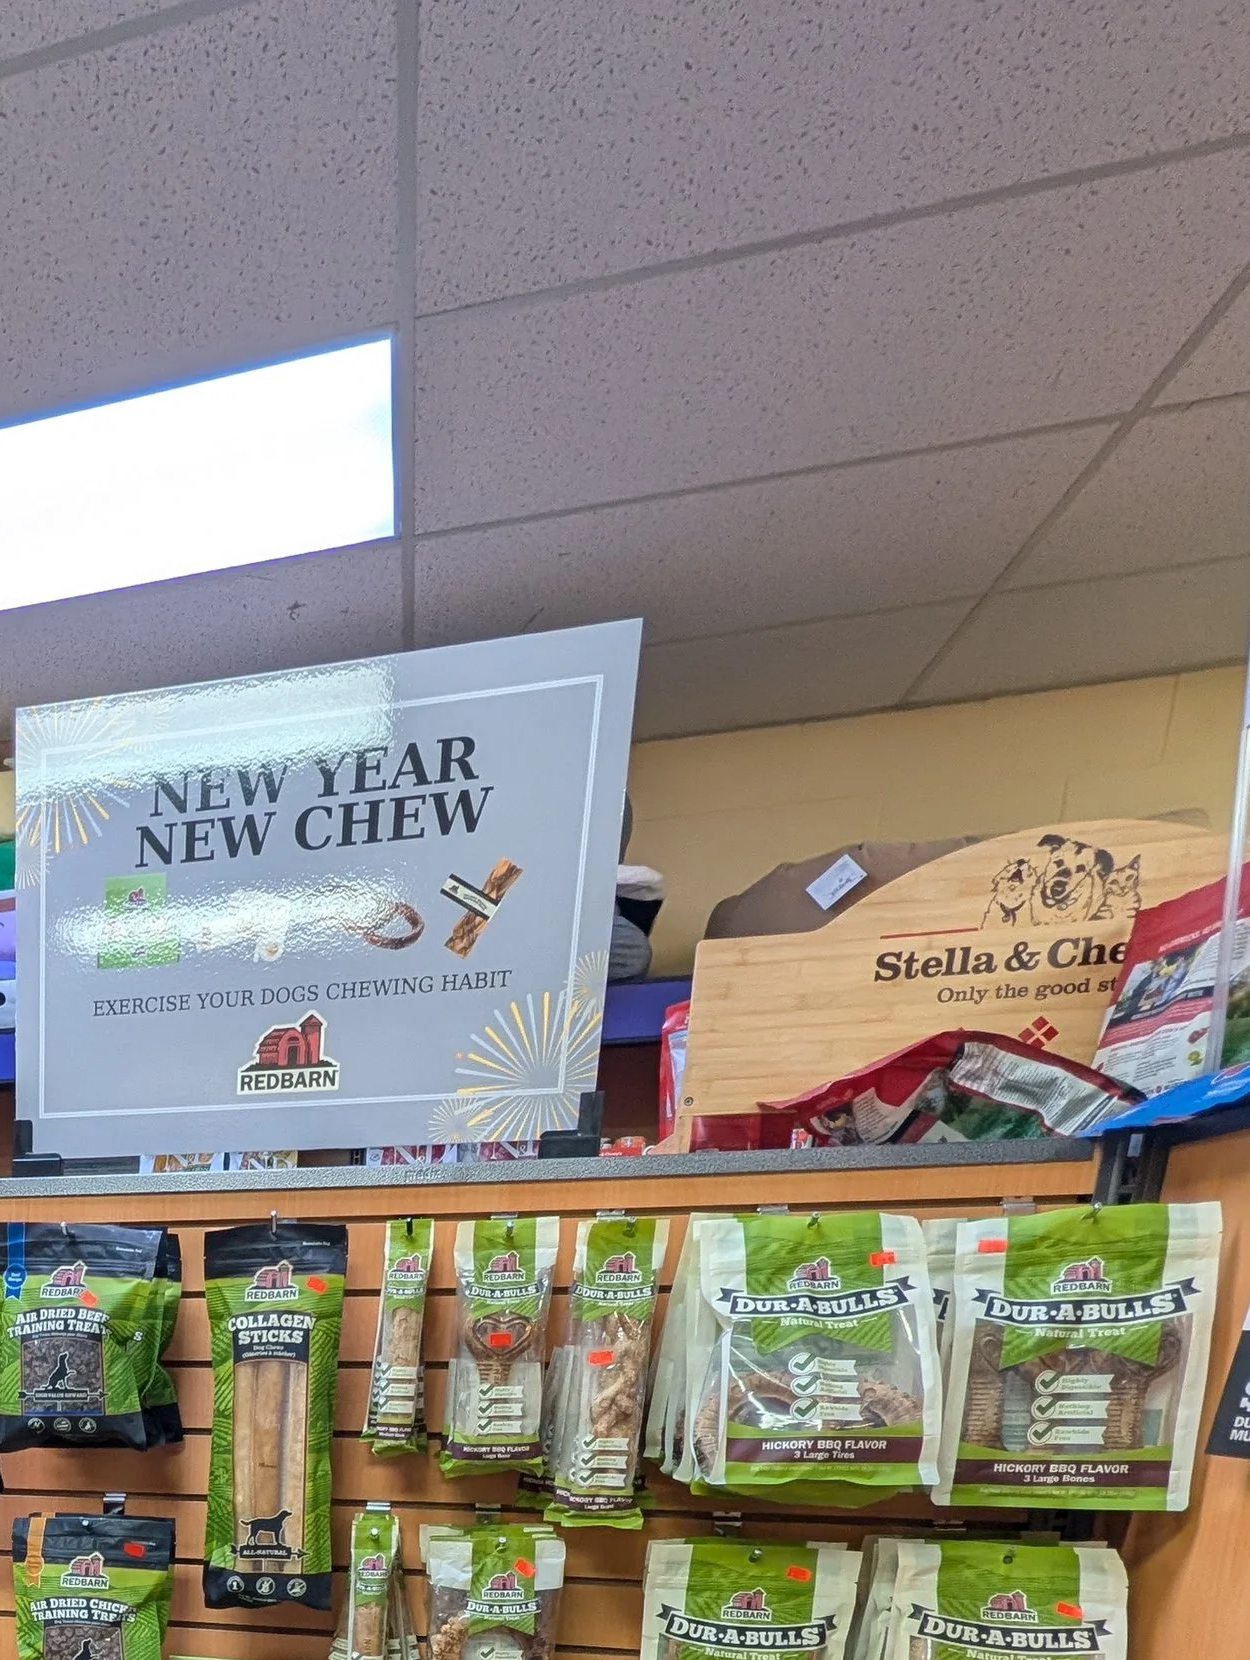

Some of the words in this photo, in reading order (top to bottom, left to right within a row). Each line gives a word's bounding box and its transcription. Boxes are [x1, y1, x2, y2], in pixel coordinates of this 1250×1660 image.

[149, 764, 288, 818] NEW
[316, 735, 479, 799] YEAR
[135, 812, 277, 868] NEW
[294, 786, 493, 852] CHEW
[874, 946, 996, 982] Stella
[1004, 942, 1039, 972] &
[92, 993, 191, 1017] EXERCISE
[196, 988, 256, 1009] YOUR
[260, 984, 319, 1006] DOGS
[325, 974, 435, 1001] CHEWING
[441, 969, 512, 992] HABIT
[937, 985, 989, 1005] Only
[994, 981, 1030, 999] the
[1034, 978, 1090, 1001] good
[240, 1069, 338, 1092] REDBARN
[484, 1273, 524, 1281] REDBARN
[597, 1274, 640, 1282] REDBARN
[1053, 1283, 1110, 1292] REDBARN
[247, 1290, 297, 1300] REDBARN
[16, 1313, 37, 1325] AIR
[40, 1309, 76, 1320] DRIED
[78, 1309, 110, 1322] BEEF
[228, 1314, 316, 1331] COLLAGEN
[780, 1317, 823, 1328] Natural
[825, 1320, 858, 1329] Treat
[7, 1321, 65, 1338] TRAINING
[1035, 1328, 1083, 1338] Natural
[1088, 1328, 1126, 1338] Treat
[238, 1330, 304, 1345] STICKS
[762, 1441, 814, 1450] HICKORY
[817, 1440, 842, 1449] BBQ
[844, 1440, 886, 1449] FLAVOR
[803, 1451, 829, 1460] Large
[993, 1464, 1046, 1473] HICKORY
[1050, 1464, 1077, 1473] BBQ
[1080, 1464, 1129, 1474] FLAVOR
[1033, 1475, 1059, 1484] Large
[1062, 1475, 1095, 1483] Bones
[62, 1576, 109, 1588] REDBARN
[30, 1600, 47, 1613] AIR
[50, 1598, 86, 1609] DRIED
[31, 1609, 89, 1622] TRAINING
[722, 1611, 771, 1619] REDBARN
[982, 1611, 1036, 1621] REDBARN
[705, 1647, 747, 1660] Natural
[749, 1653, 781, 1660] Treat
